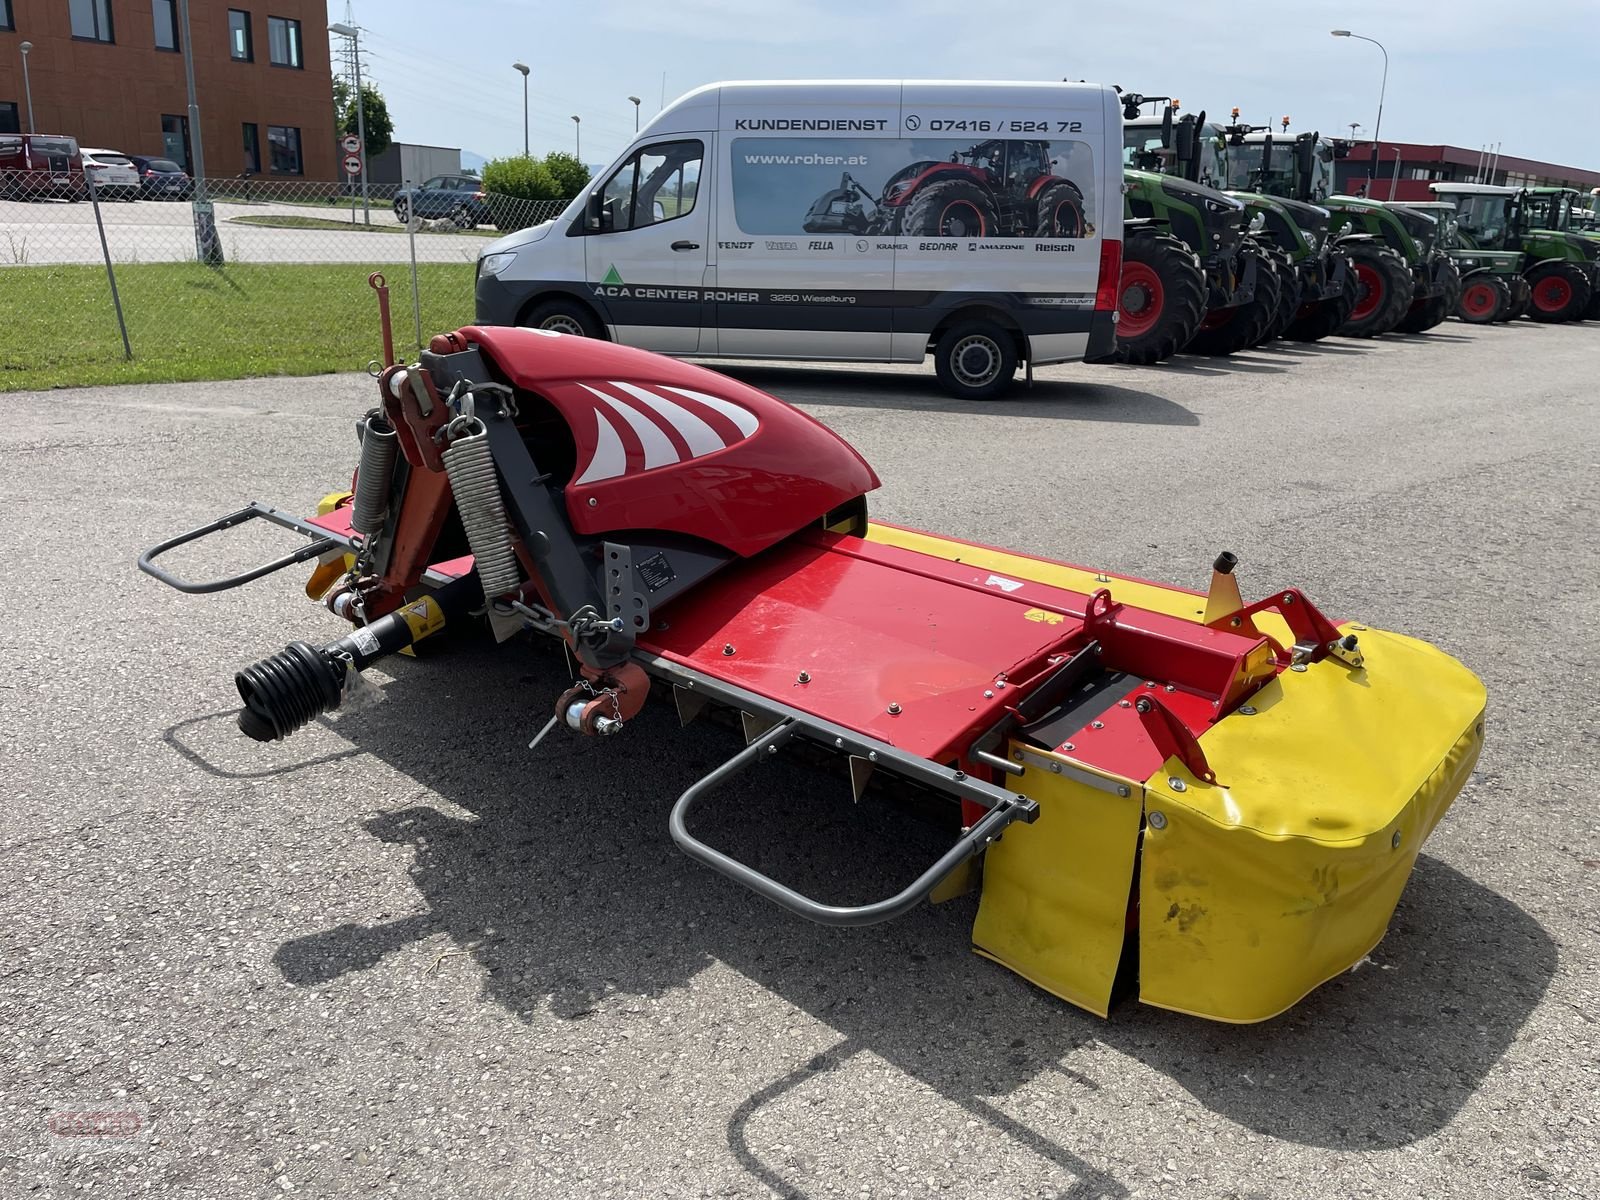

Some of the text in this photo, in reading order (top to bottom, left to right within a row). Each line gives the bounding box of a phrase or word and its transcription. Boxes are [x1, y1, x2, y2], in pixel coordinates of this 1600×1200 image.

[735, 119, 888, 131] KUNDENDIENST
[930, 120, 1082, 133] 07416 / 524 72
[745, 154, 868, 165] www.roher.at
[718, 241, 755, 250] FENDT
[808, 241, 834, 250] FELLA
[919, 242, 958, 251] BEDNAR
[1035, 243, 1075, 252] Reisch
[593, 286, 857, 304] ACA CENTER ROHER 3250 Wieselburg
